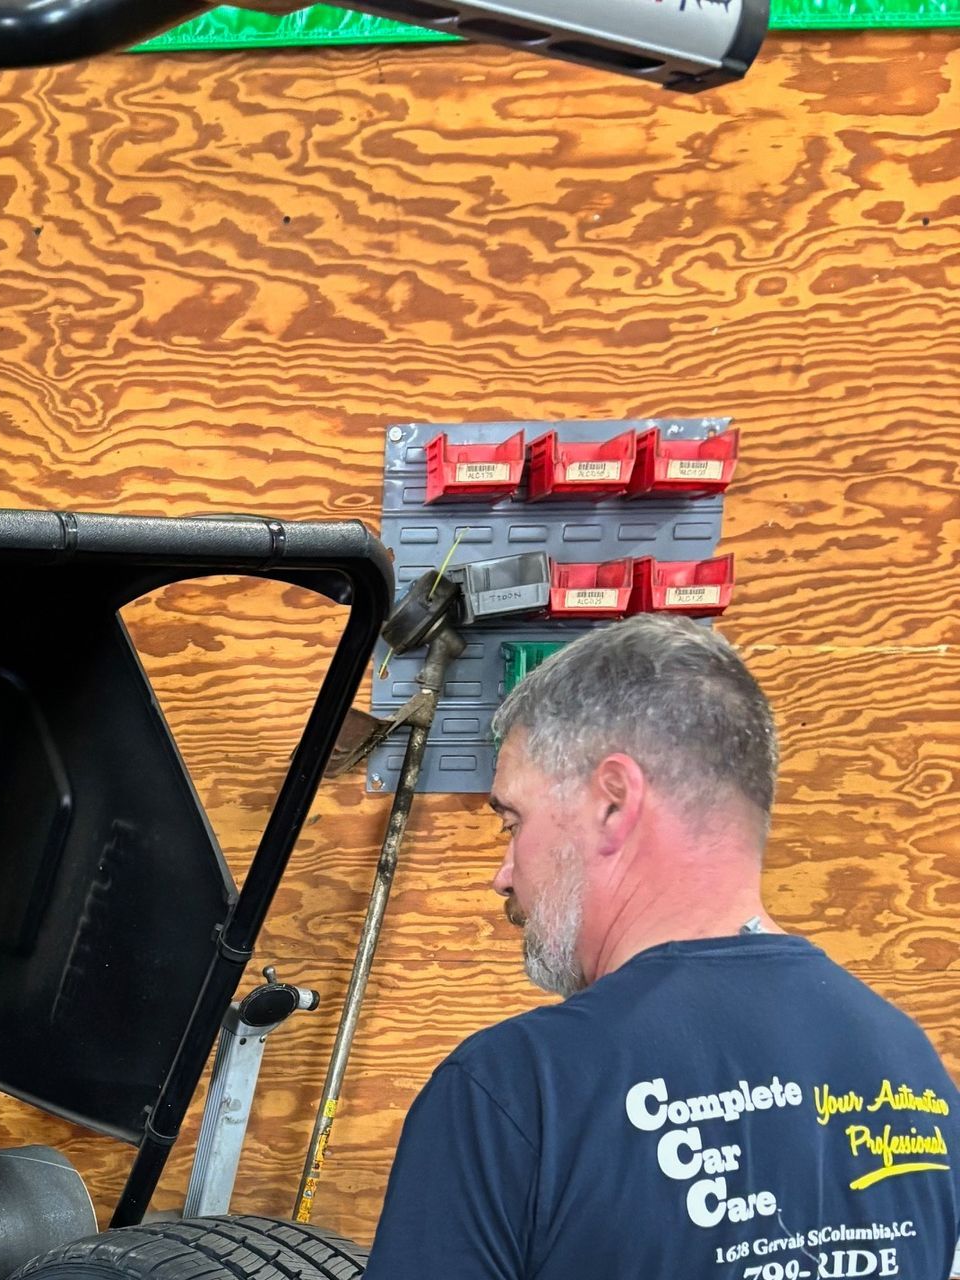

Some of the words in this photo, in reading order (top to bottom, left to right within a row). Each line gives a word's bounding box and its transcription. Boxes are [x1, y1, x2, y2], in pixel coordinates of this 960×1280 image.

[625, 1076, 803, 1132] Complete
[814, 1084, 863, 1125] Your
[657, 1126, 741, 1180] Car
[686, 1176, 776, 1228] Care
